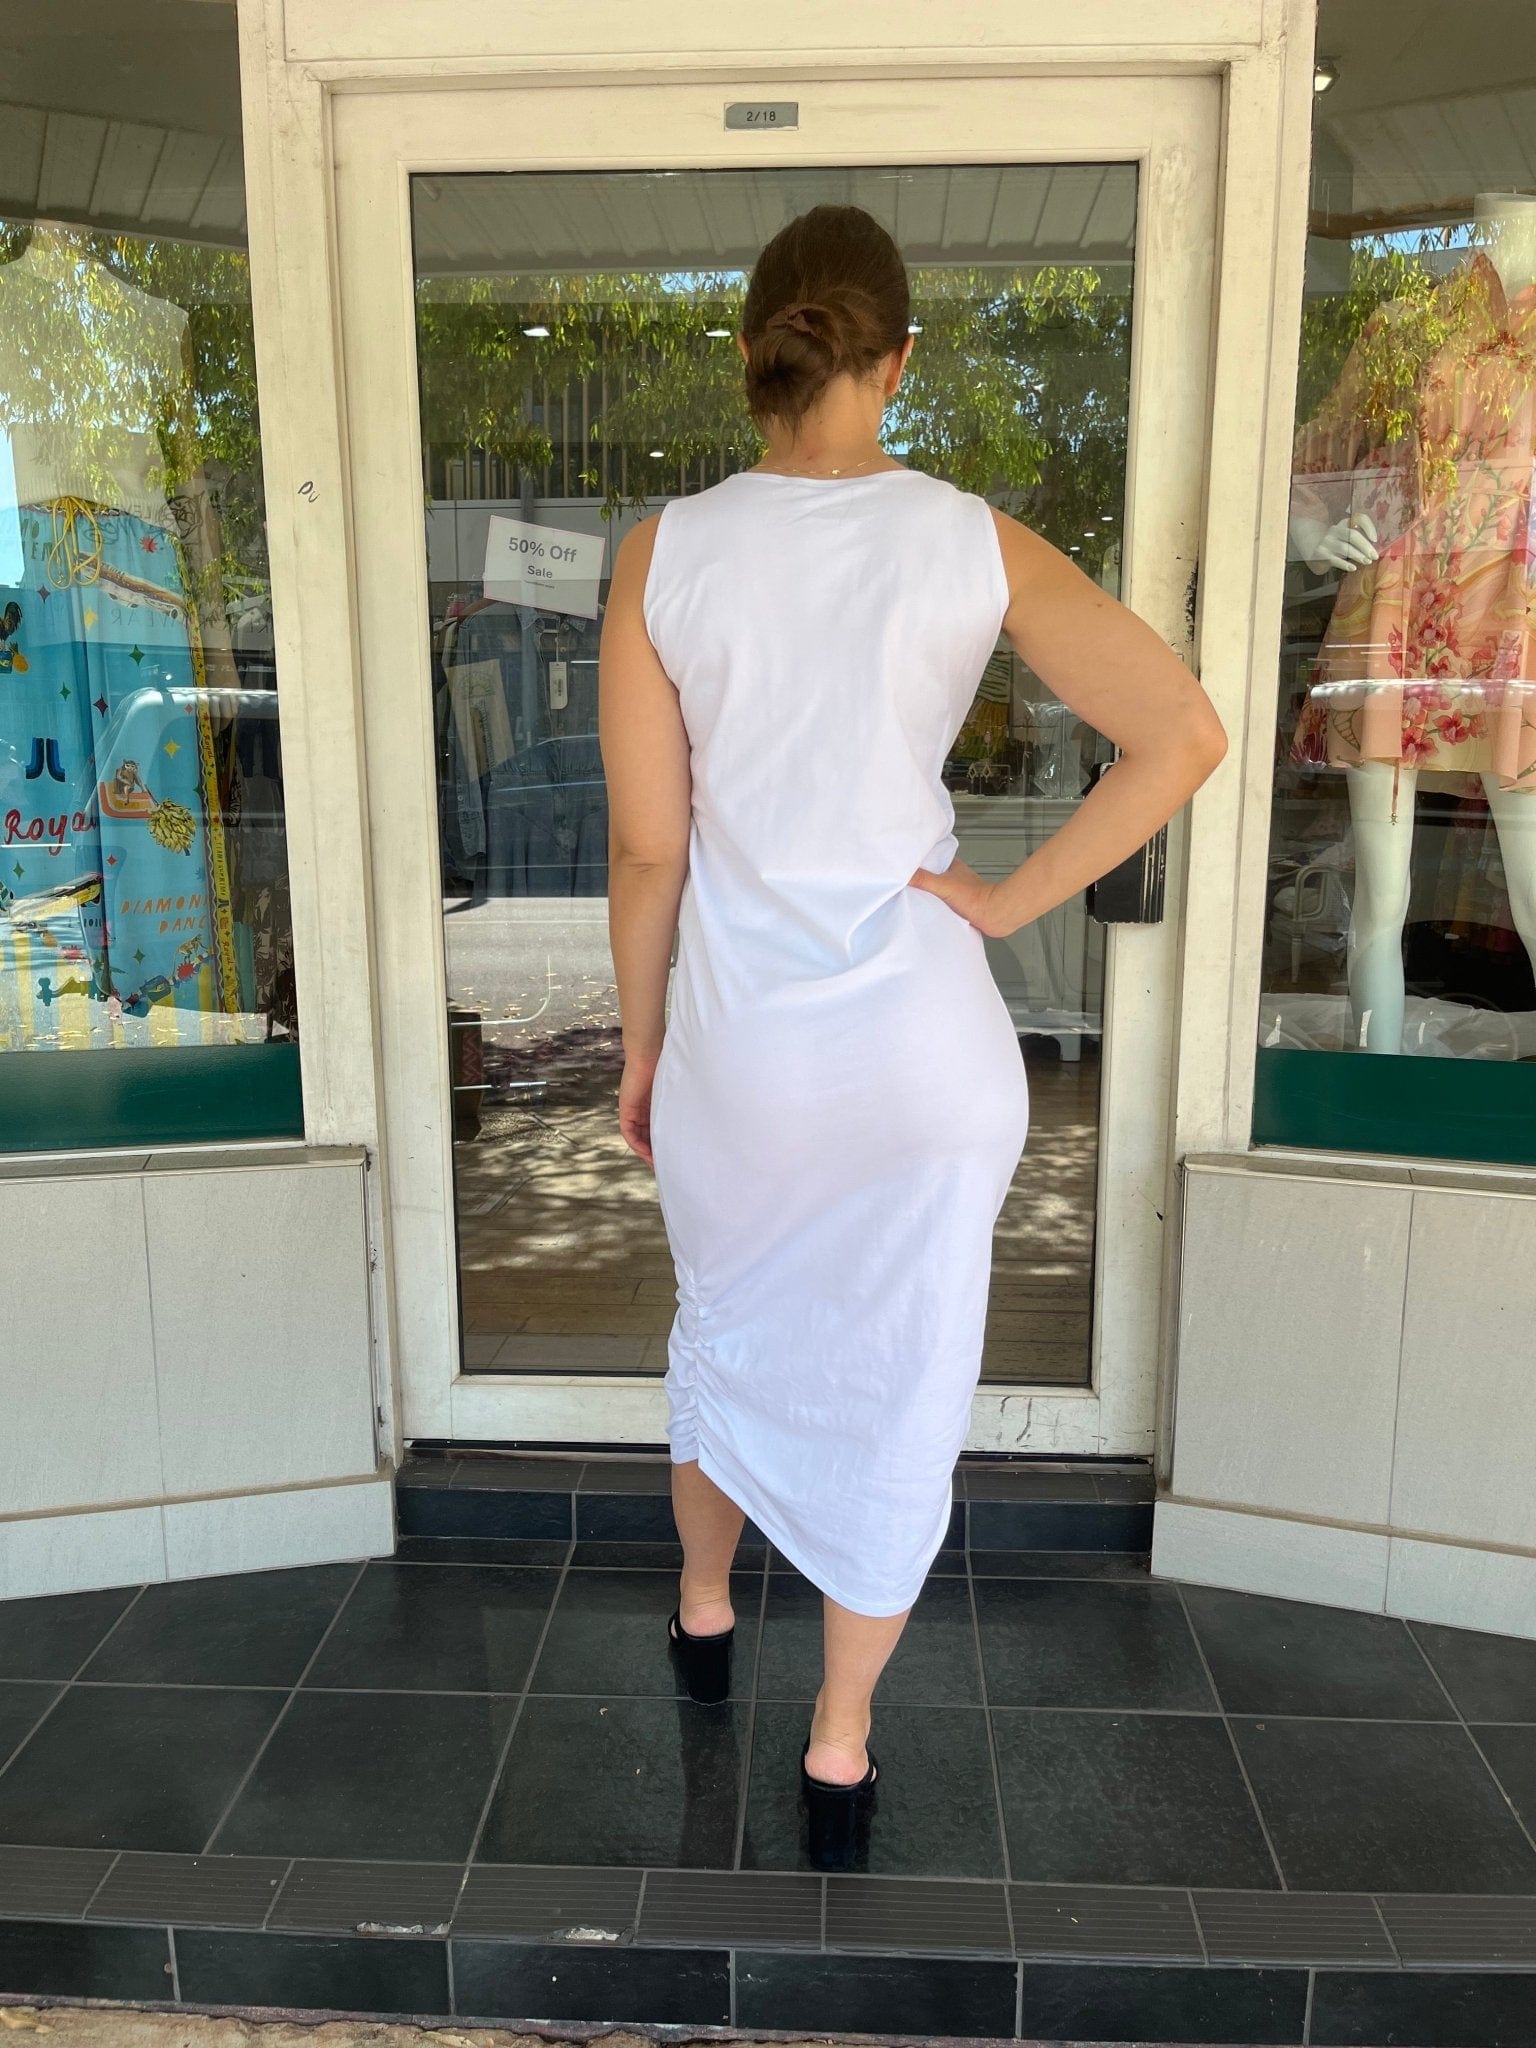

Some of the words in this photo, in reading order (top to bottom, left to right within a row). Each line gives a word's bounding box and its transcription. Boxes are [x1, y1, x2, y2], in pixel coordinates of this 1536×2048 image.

[746, 110, 776, 122] 2/18
[508, 536, 545, 557] 50%
[550, 545, 577, 562] Off
[527, 565, 553, 579] Sale
